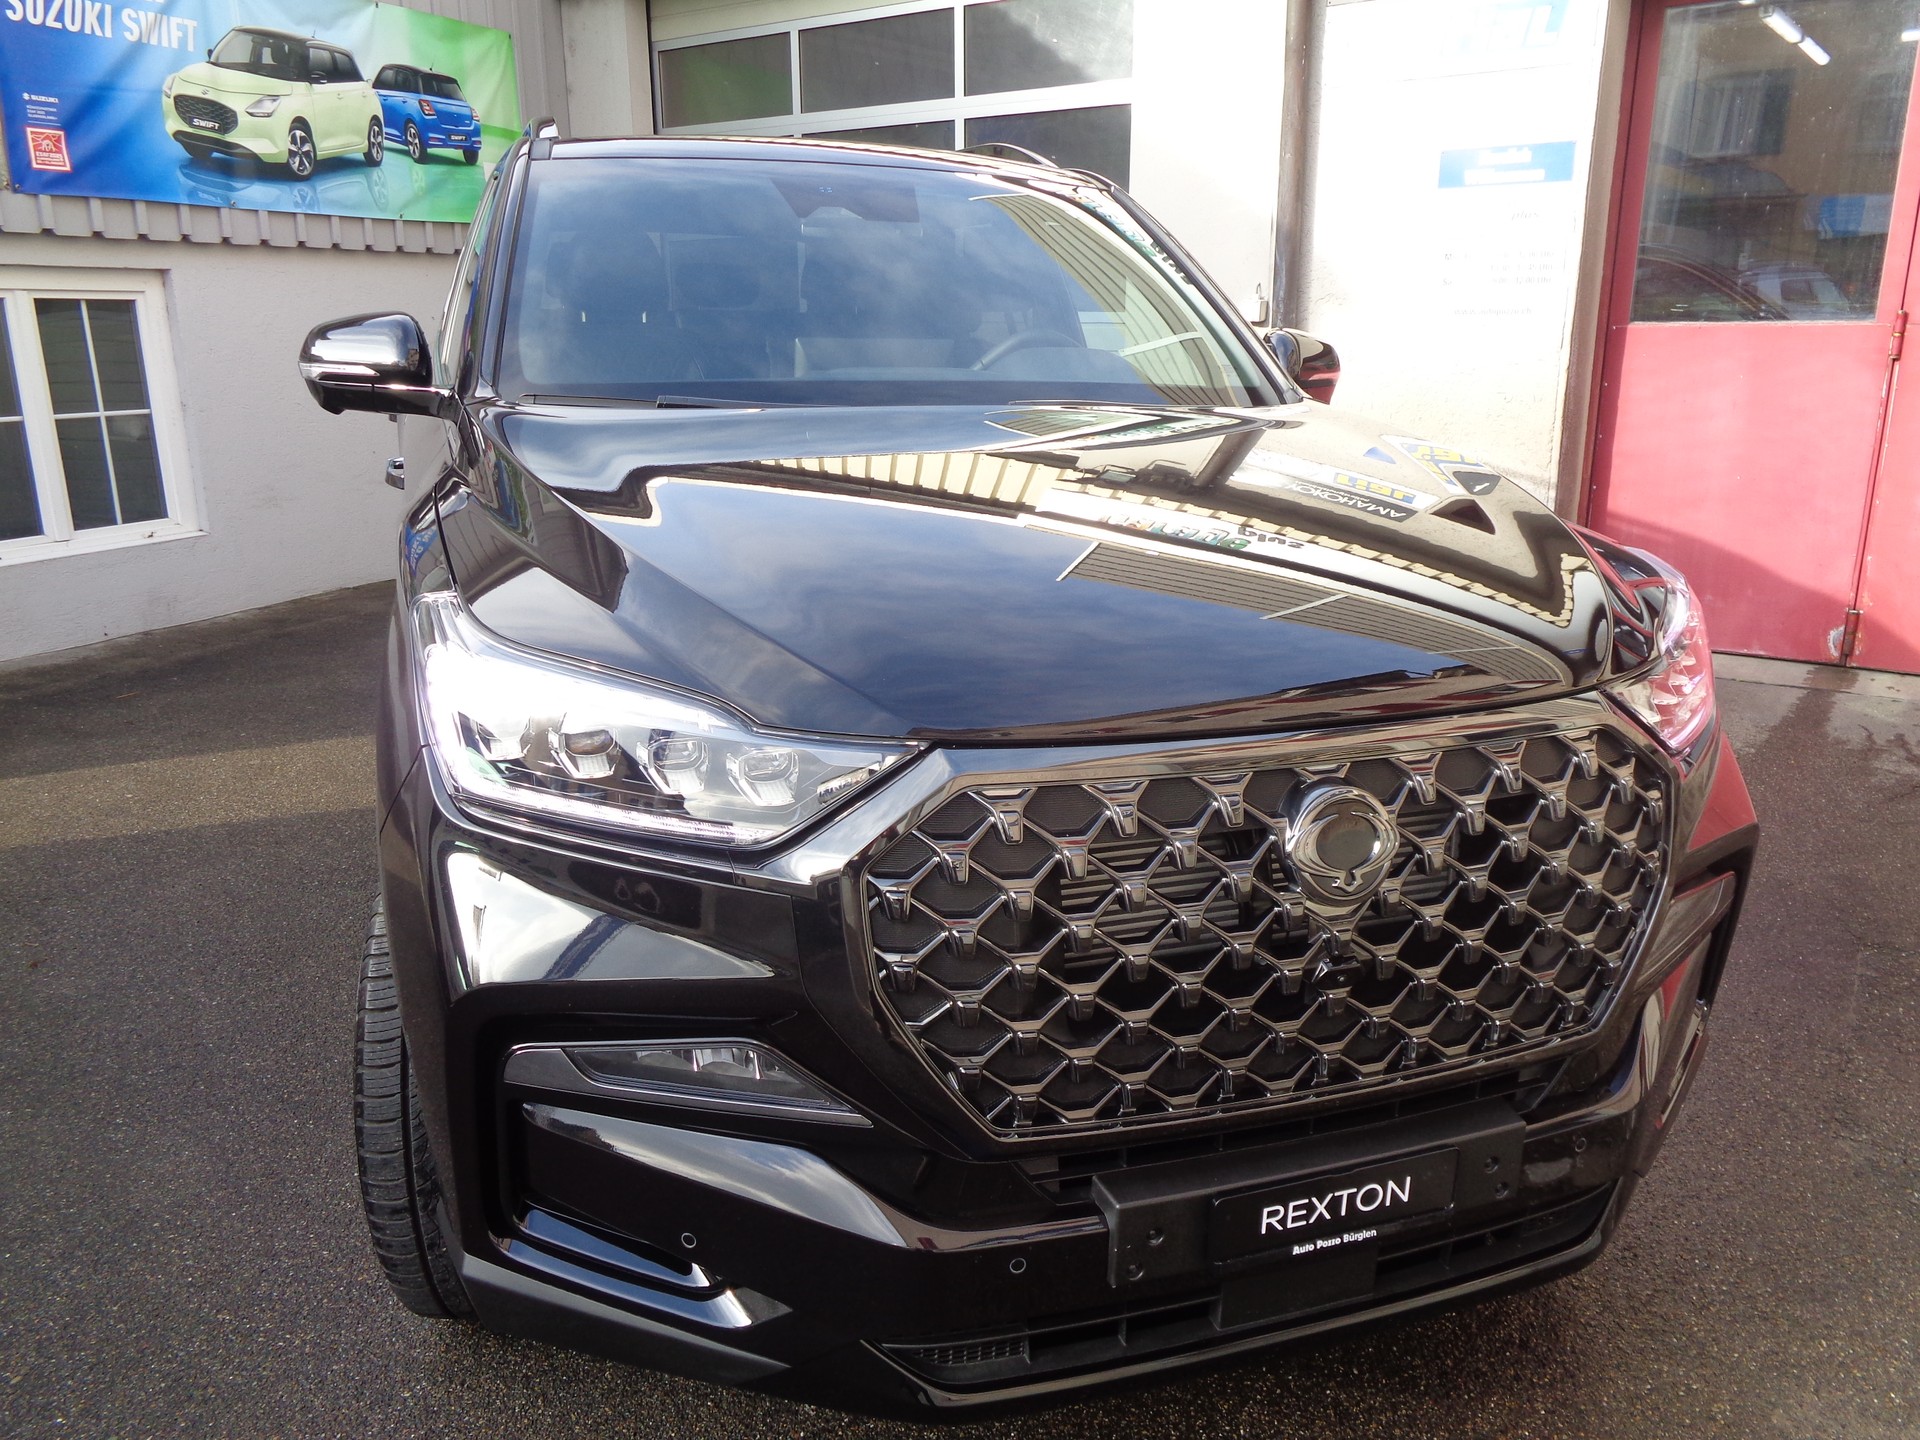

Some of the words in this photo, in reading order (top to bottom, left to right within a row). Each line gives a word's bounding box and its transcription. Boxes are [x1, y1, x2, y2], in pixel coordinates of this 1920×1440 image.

[5, 0, 113, 38] SUZUKI
[121, 8, 198, 52] SWIFT
[192, 118, 220, 130] SWIFT
[1260, 1176, 1411, 1235] REXTON
[1292, 1243, 1315, 1256] Auto
[1343, 1228, 1377, 1243] Bürglen
